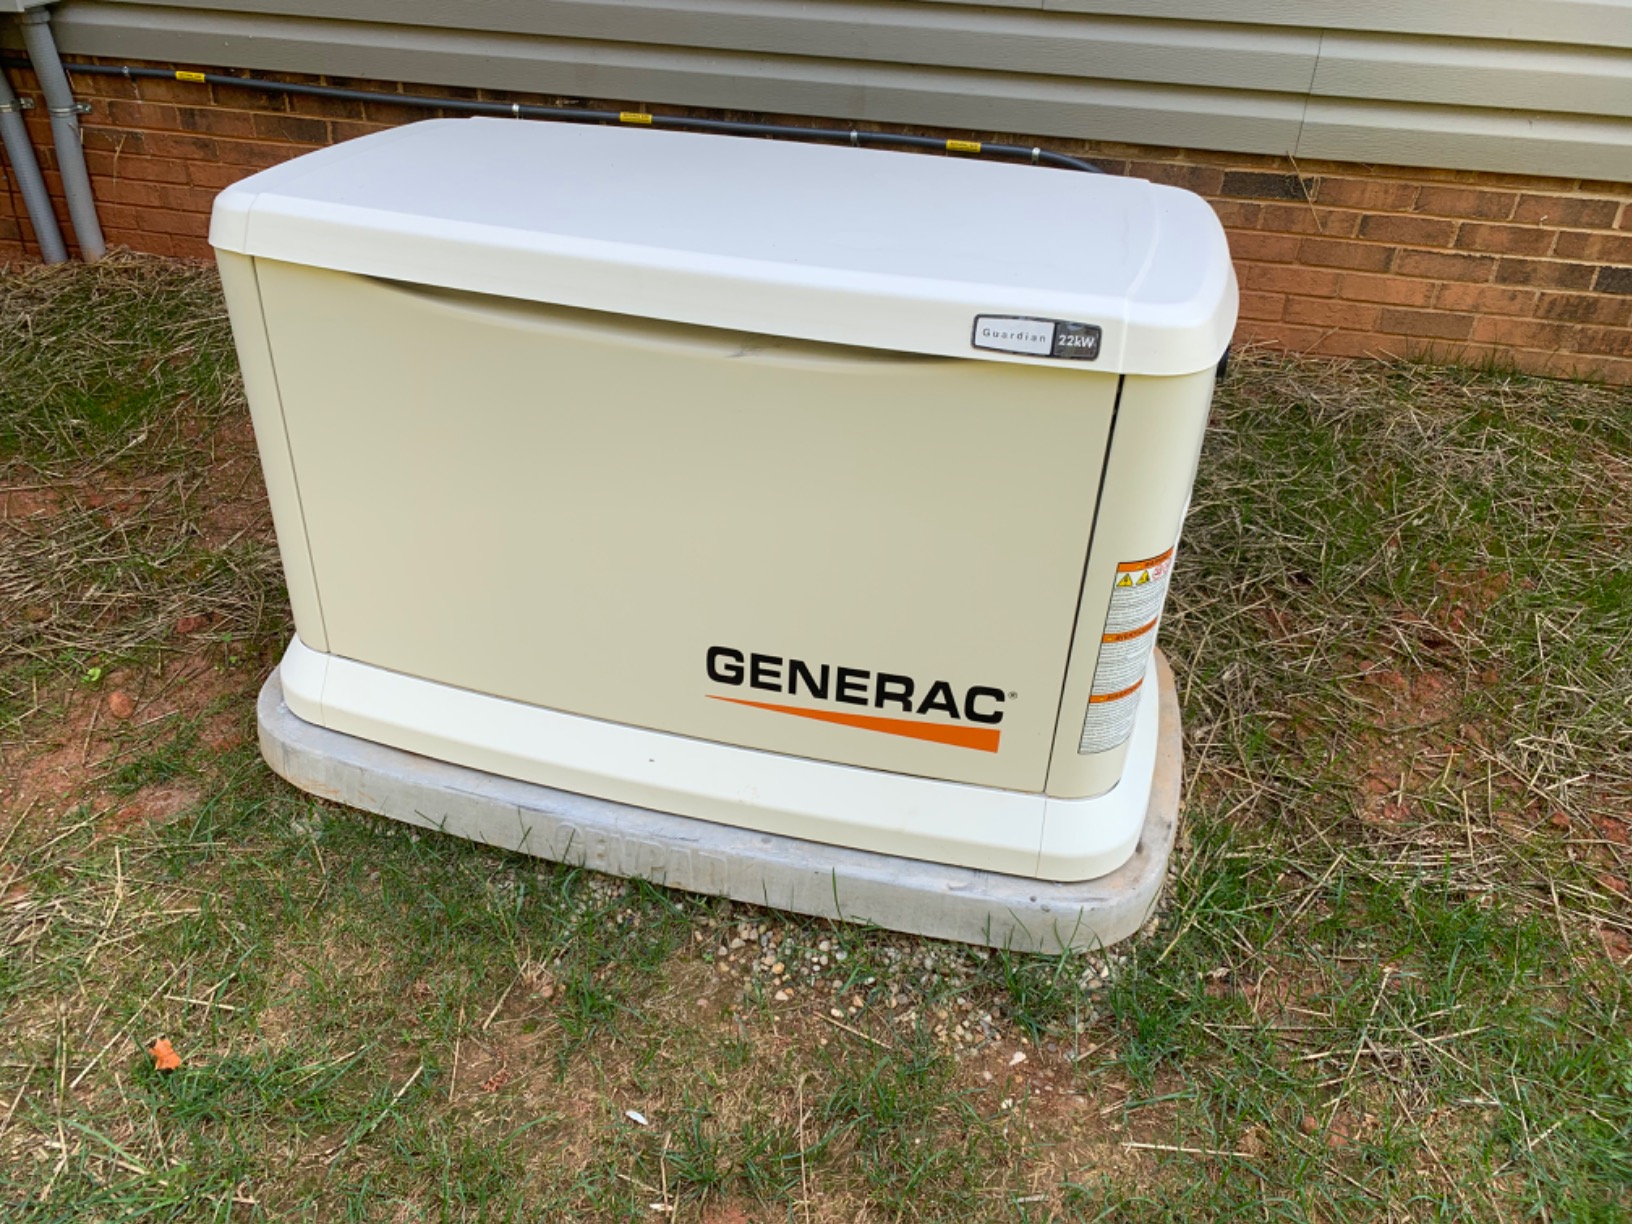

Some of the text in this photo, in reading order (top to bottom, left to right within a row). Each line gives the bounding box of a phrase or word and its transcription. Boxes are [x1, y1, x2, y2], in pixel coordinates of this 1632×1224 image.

[982, 327, 1095, 349] Guardian 22kW
[705, 645, 1006, 725] GENERAC
